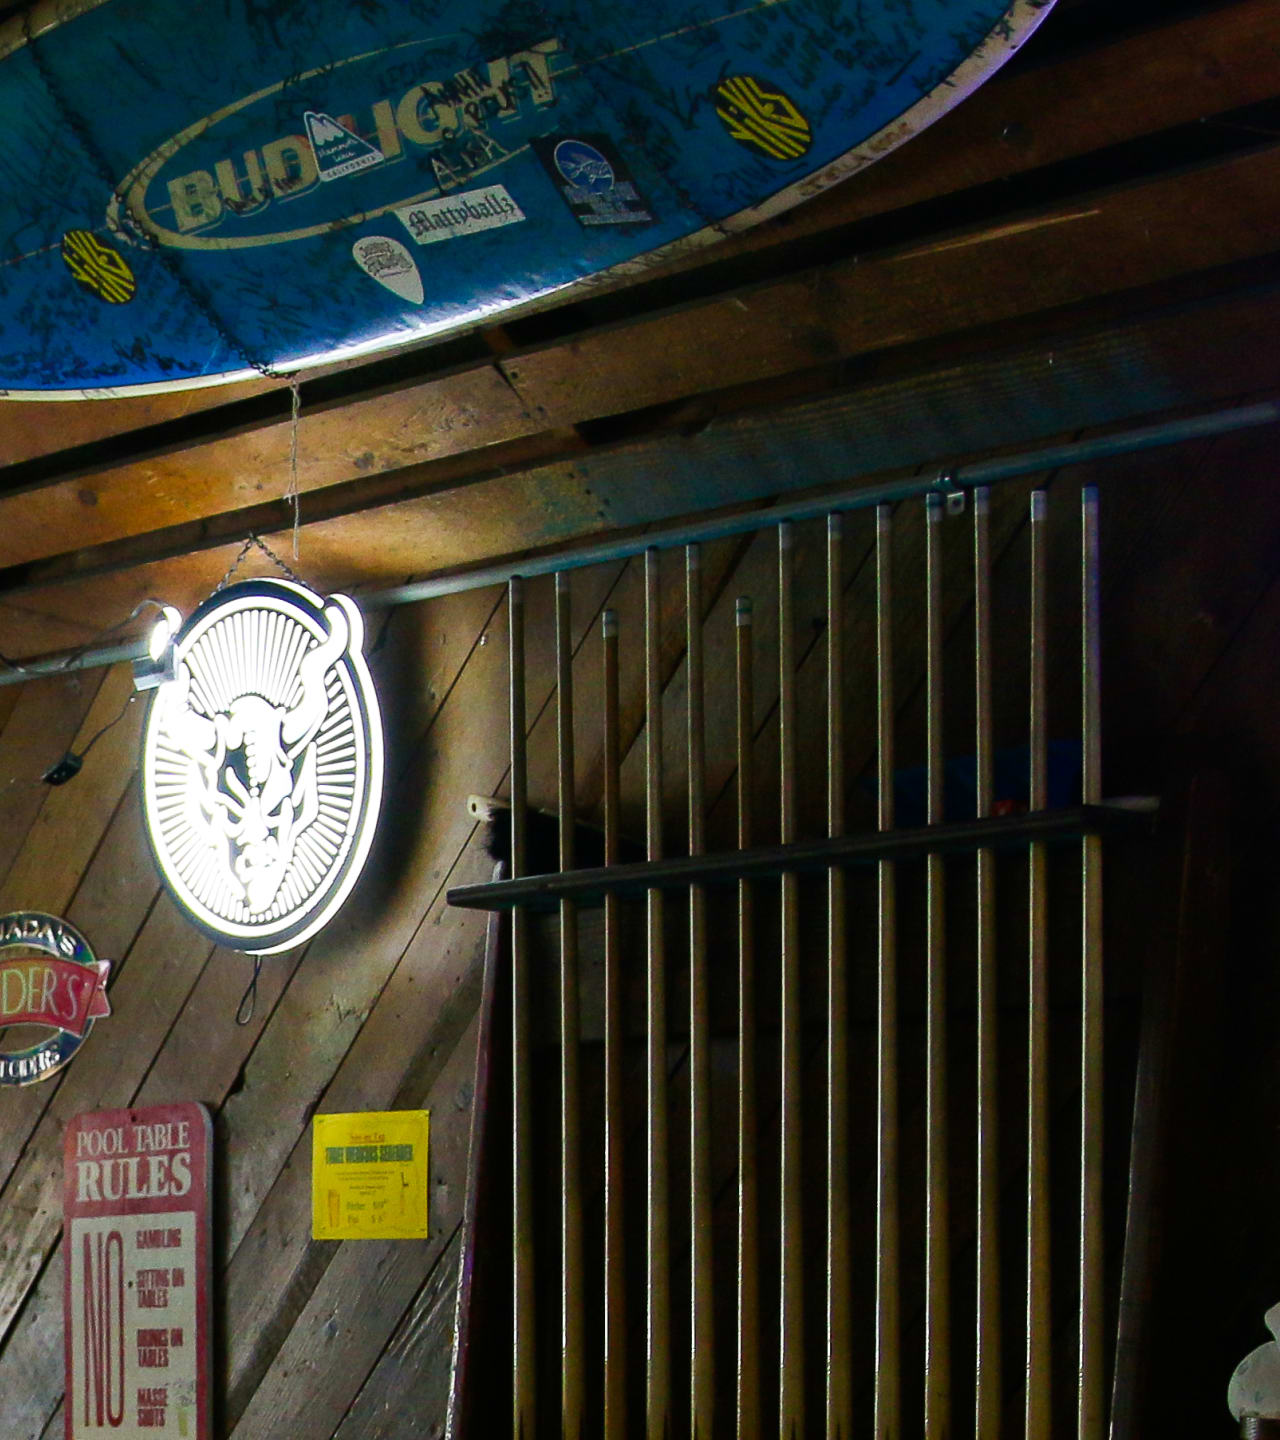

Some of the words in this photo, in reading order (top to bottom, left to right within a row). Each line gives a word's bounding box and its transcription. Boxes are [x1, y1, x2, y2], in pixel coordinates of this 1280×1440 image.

[167, 134, 320, 233] BUD
[336, 38, 560, 158] IGHT
[75, 1151, 192, 1203] RULES
[76, 1126, 129, 1158] POOL
[132, 1121, 192, 1153] TABLE
[83, 1230, 124, 1429] NO
